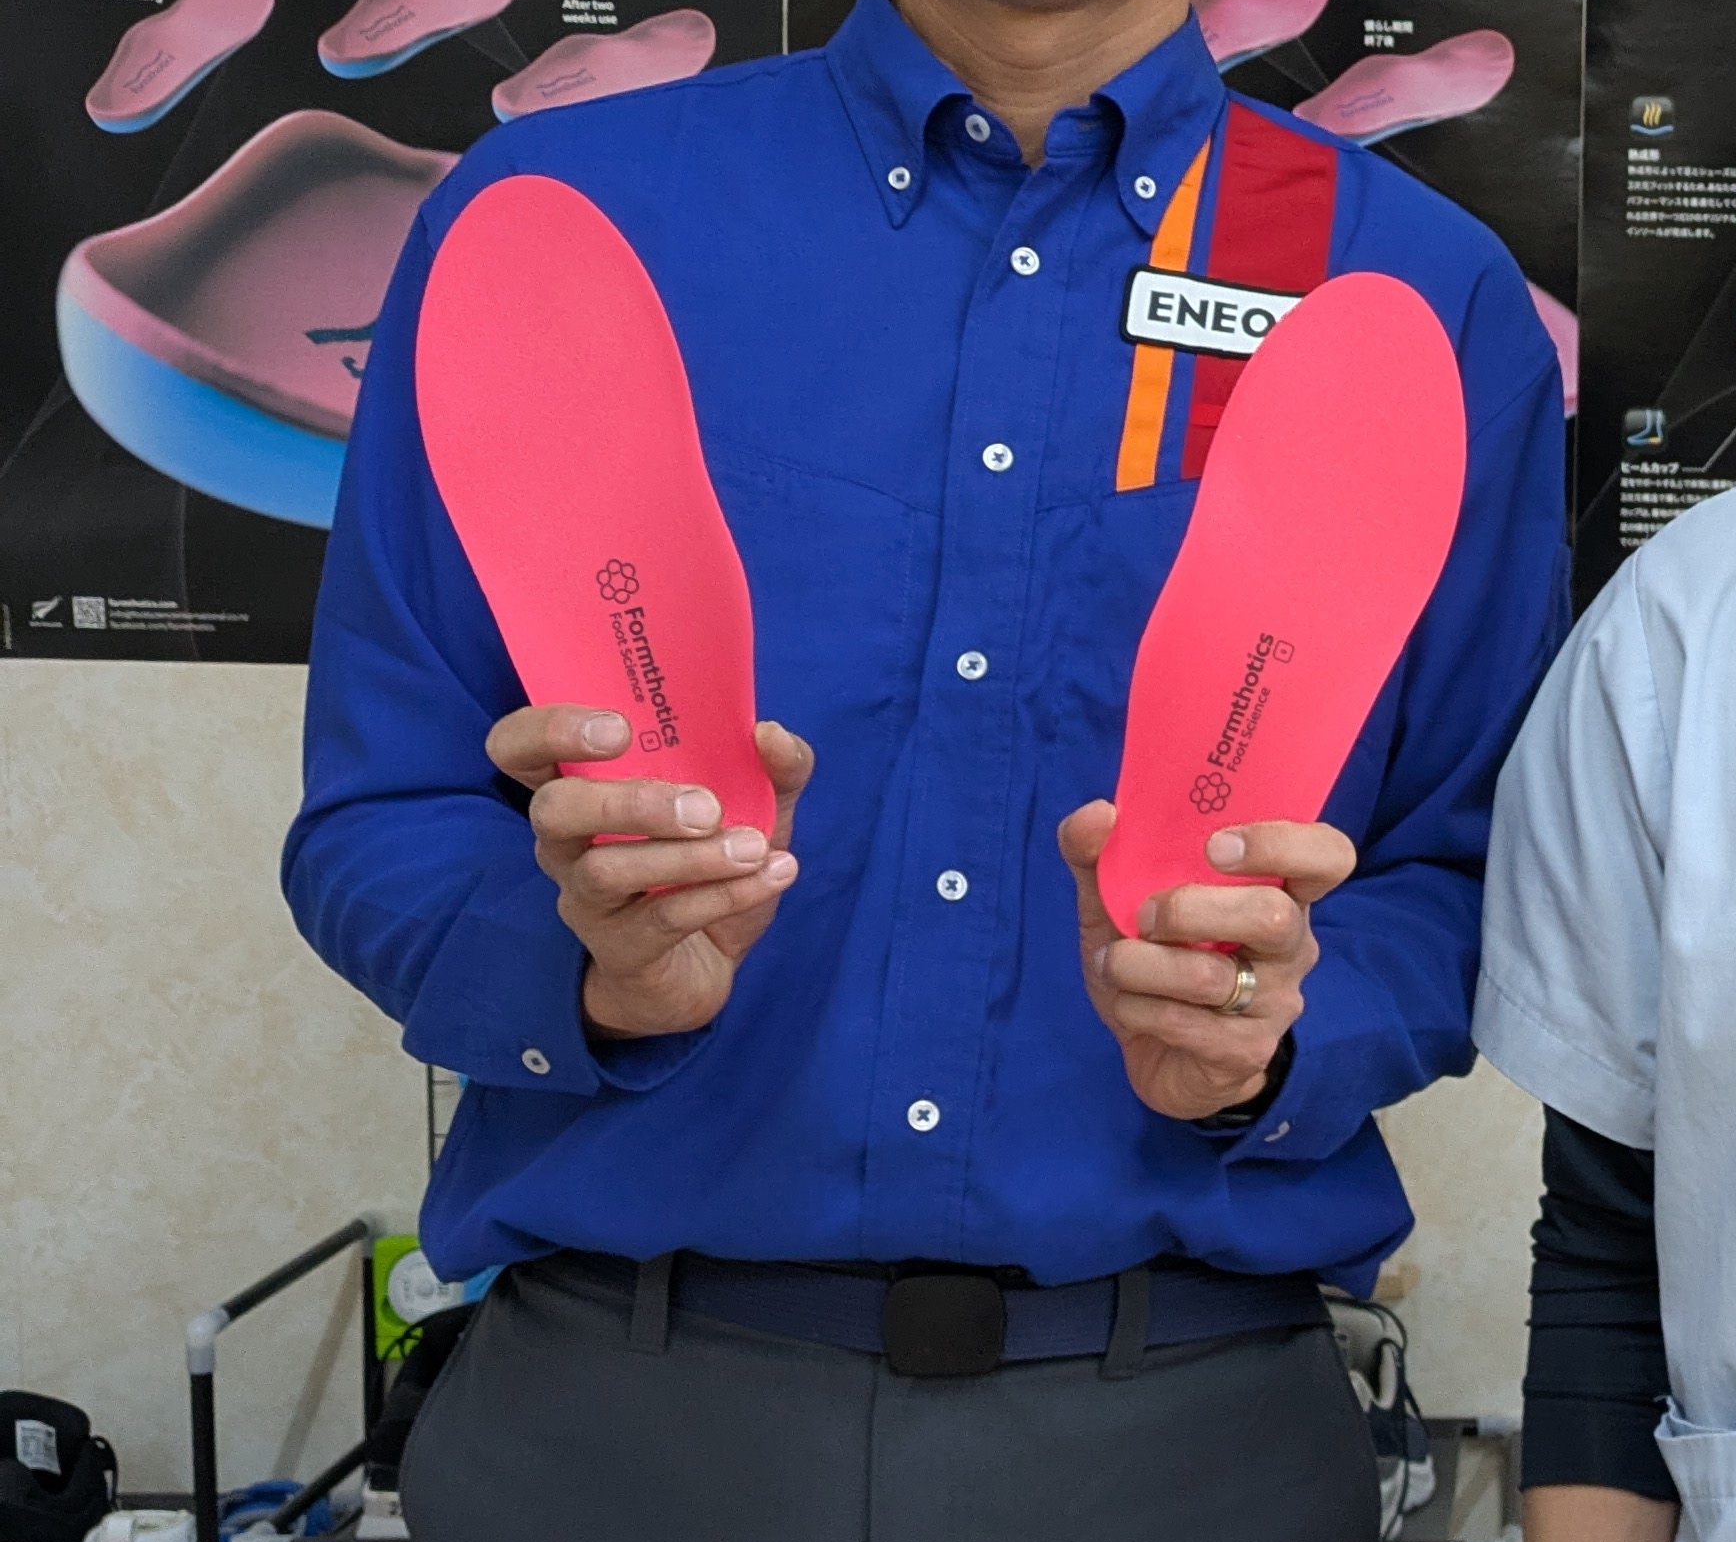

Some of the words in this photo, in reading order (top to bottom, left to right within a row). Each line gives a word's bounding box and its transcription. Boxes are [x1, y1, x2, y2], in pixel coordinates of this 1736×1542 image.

[562, 12, 597, 25] weeks
[598, 15, 618, 26] use
[609, 611, 628, 647] Foot
[620, 647, 645, 703] Science
[624, 606, 680, 748] Formthotics
[1206, 632, 1275, 767] Formthotics
[1226, 739, 1249, 773] Foot
[1242, 687, 1271, 740] Science
